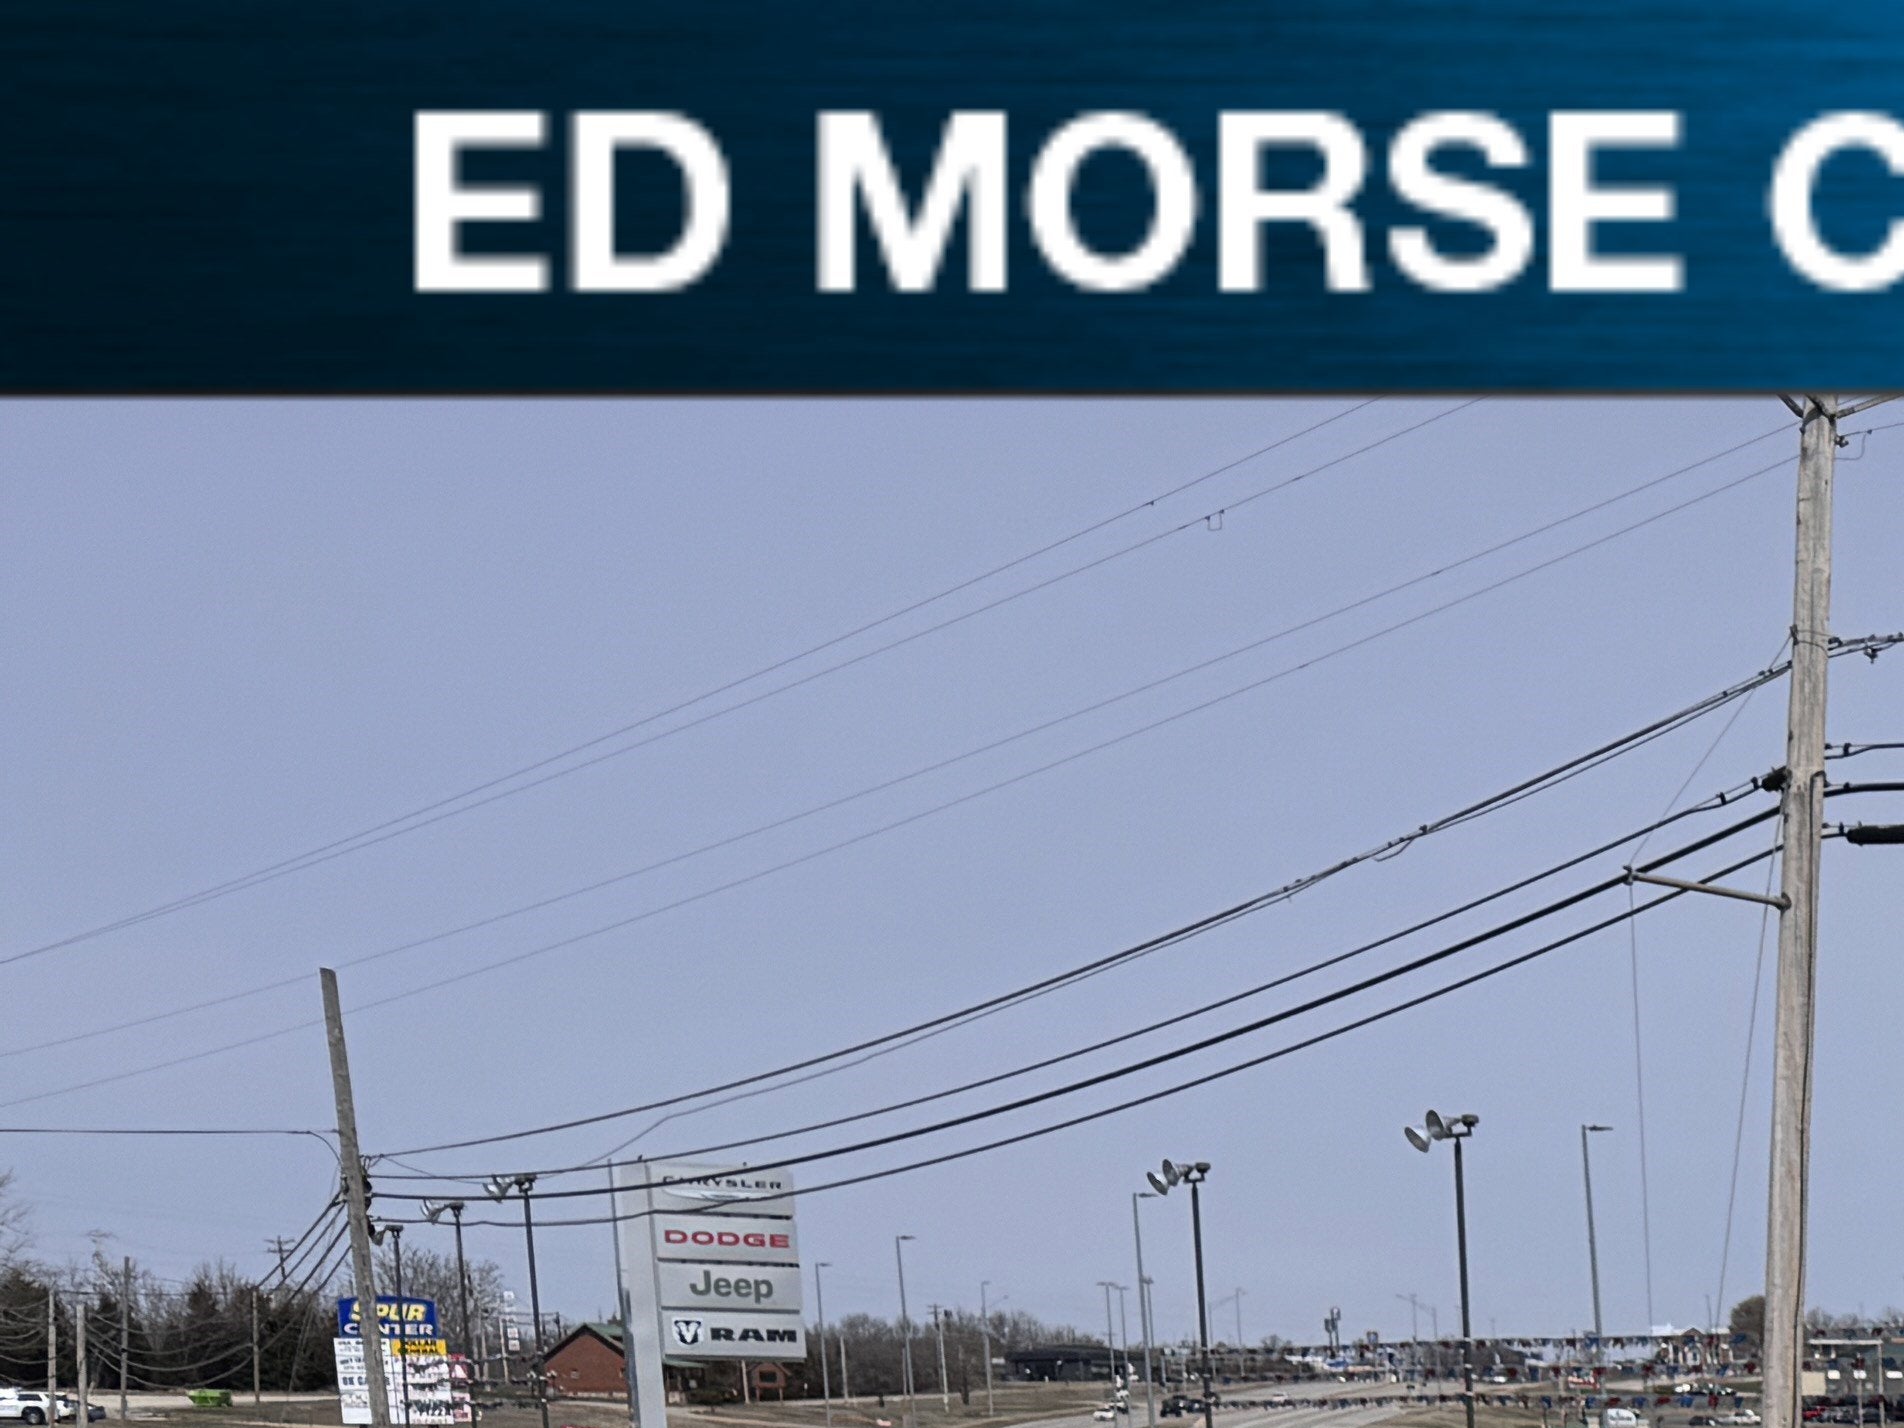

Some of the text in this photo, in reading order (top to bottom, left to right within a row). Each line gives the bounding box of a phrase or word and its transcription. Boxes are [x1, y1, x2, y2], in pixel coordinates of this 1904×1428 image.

[664, 1229, 790, 1249] DODGE
[689, 1270, 774, 1304] Jeep
[343, 1323, 434, 1336] CNTER
[710, 1327, 798, 1344] RAM
